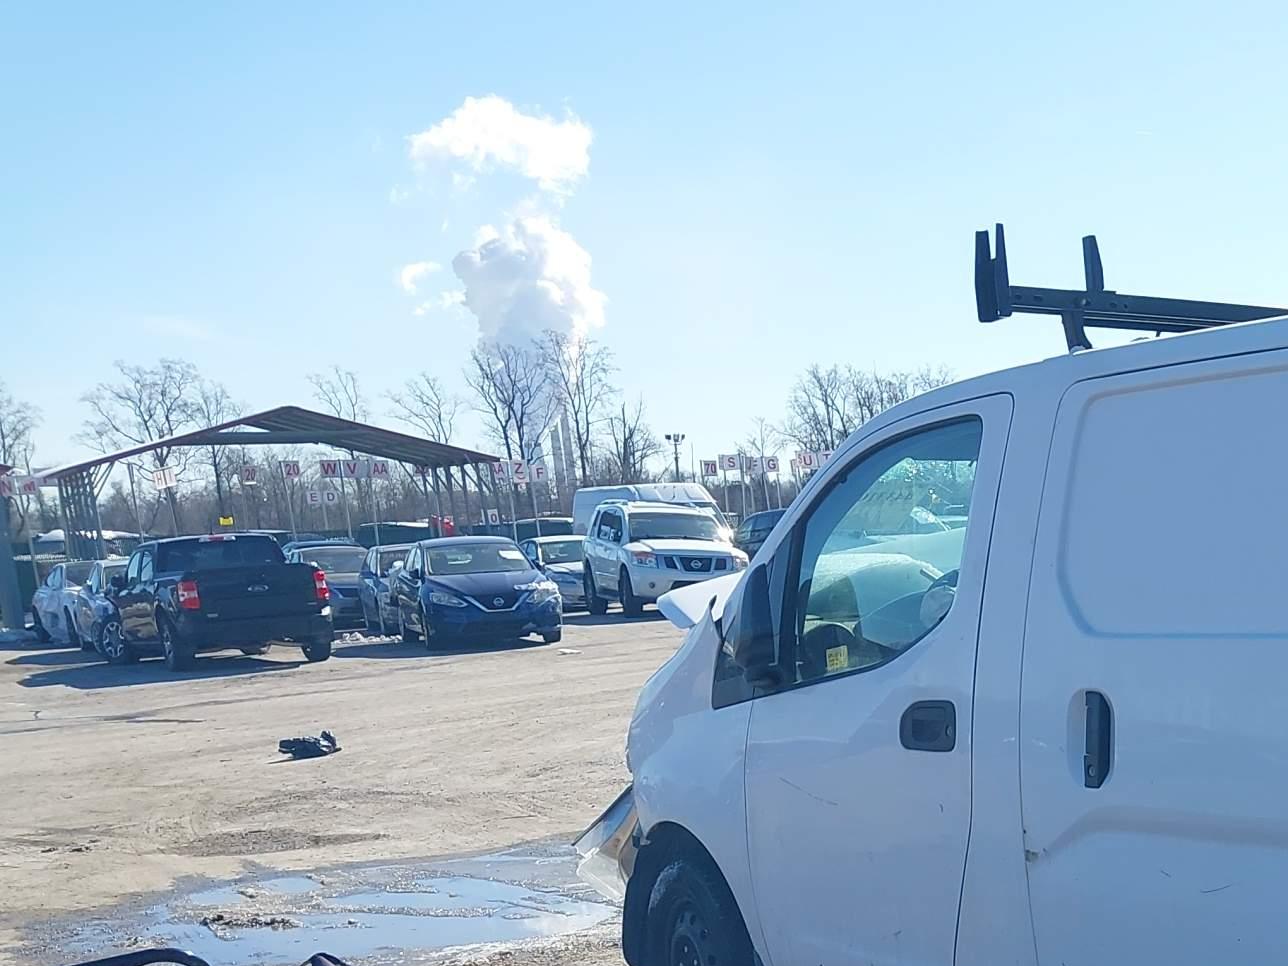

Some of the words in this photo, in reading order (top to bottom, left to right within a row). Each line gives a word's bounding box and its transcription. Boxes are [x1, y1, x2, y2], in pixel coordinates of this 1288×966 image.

[728, 457, 736, 467] S
[767, 459, 776, 470] G
[803, 454, 812, 466] U
[286, 463, 299, 476] 20
[322, 463, 336, 475] W
[346, 463, 357, 475] V
[373, 463, 388, 475] AA
[514, 462, 524, 474] Z
[536, 467, 544, 479] F
[705, 463, 716, 474] 70
